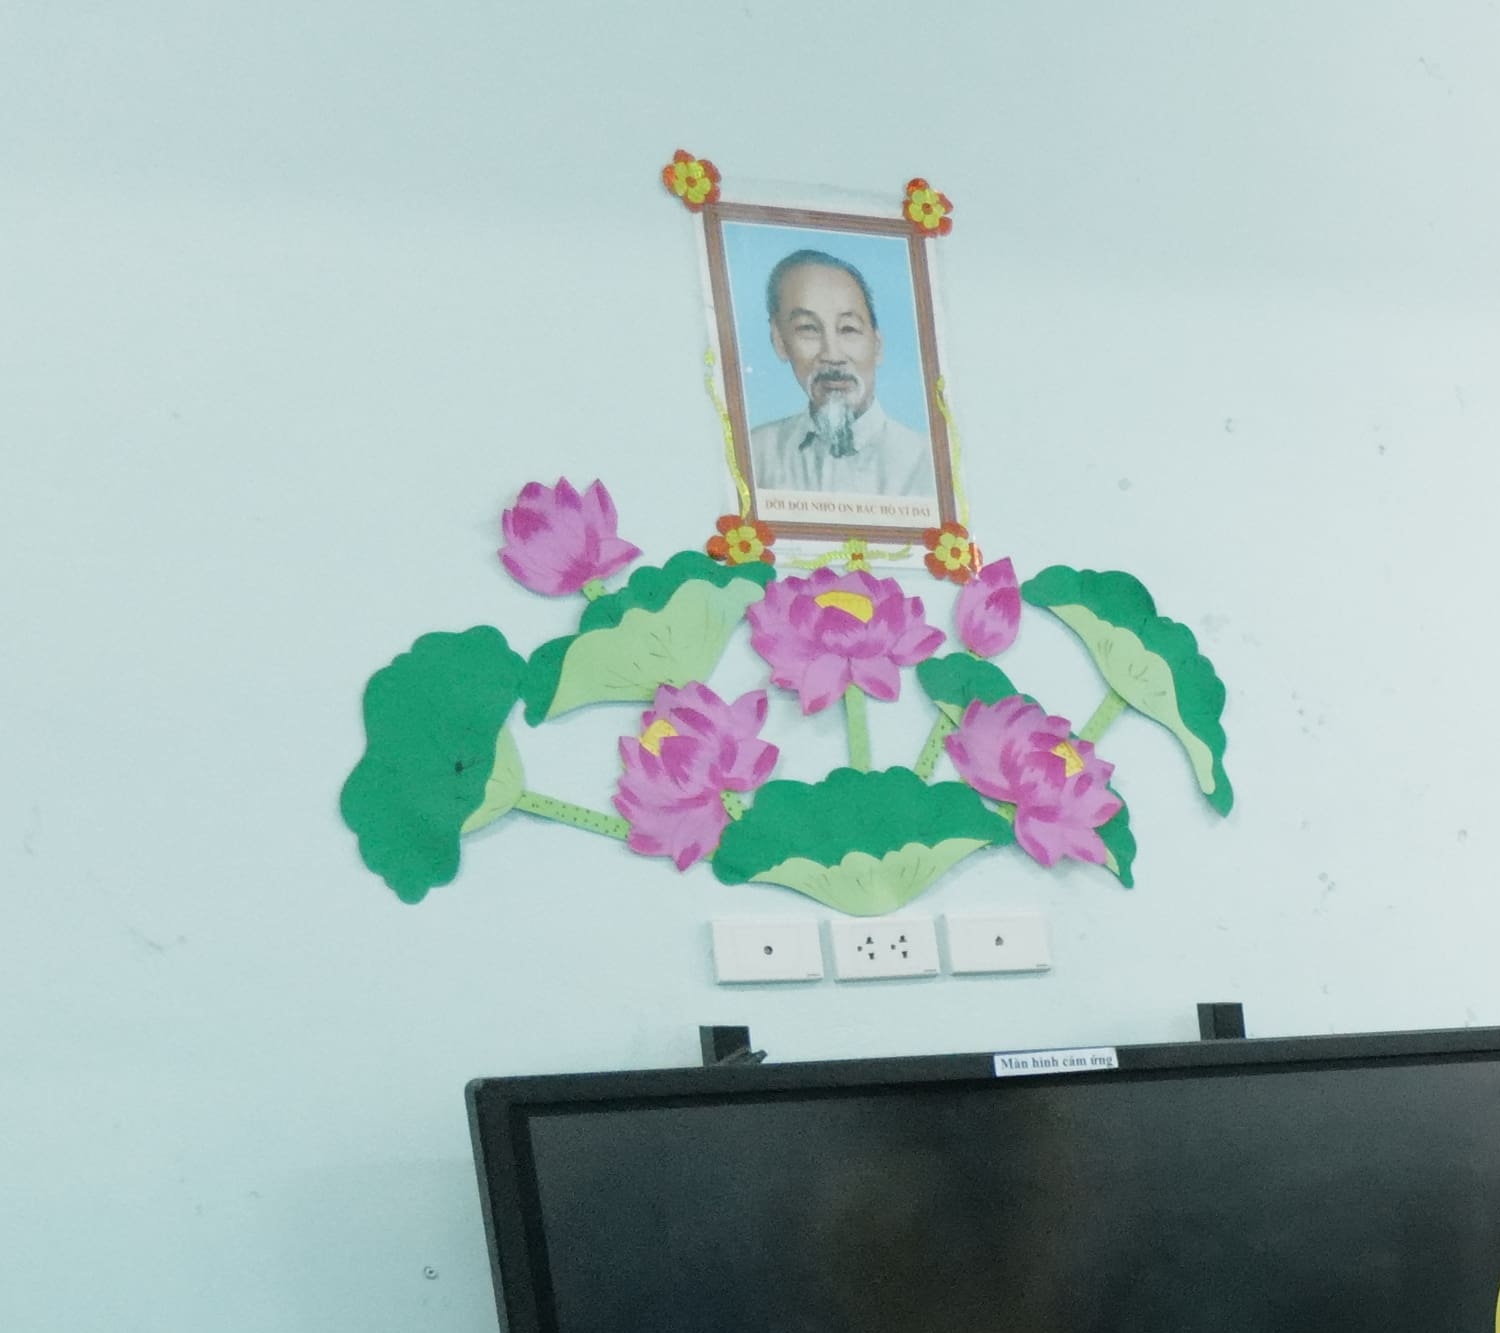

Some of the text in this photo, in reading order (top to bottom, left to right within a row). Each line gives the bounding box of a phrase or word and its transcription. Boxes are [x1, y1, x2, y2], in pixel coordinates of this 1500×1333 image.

[1001, 1058, 1029, 1070] Màn
[1032, 1056, 1059, 1069] hình
[1091, 1054, 1113, 1067] ứng
